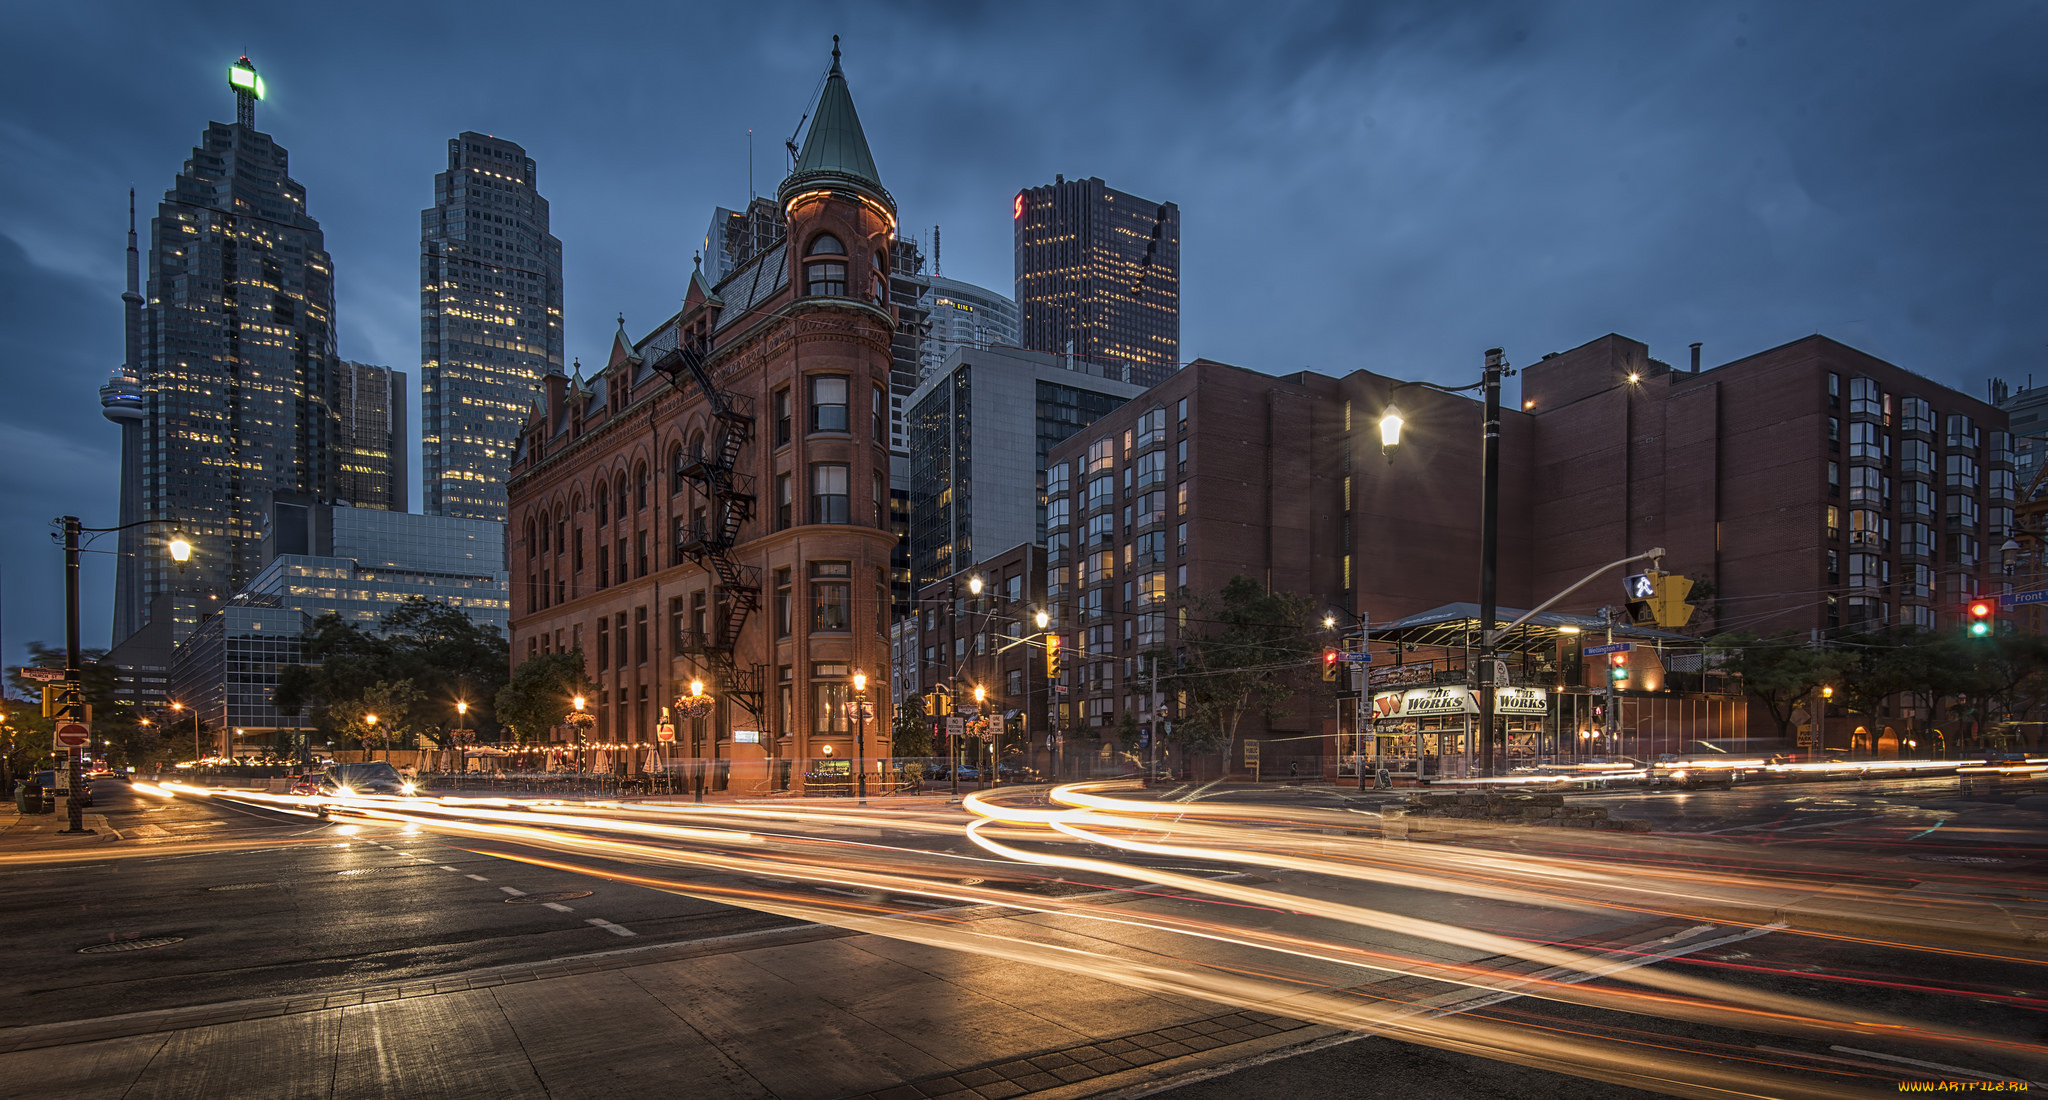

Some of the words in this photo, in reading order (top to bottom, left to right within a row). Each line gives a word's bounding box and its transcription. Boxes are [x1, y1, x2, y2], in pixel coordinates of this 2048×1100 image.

[2015, 592, 2042, 602] Front
[1588, 646, 1616, 655] Wellington
[1427, 689, 1451, 698] THE
[1515, 689, 1535, 698] THE
[1408, 696, 1464, 710] WORKS
[1500, 695, 1547, 709] WORKS
